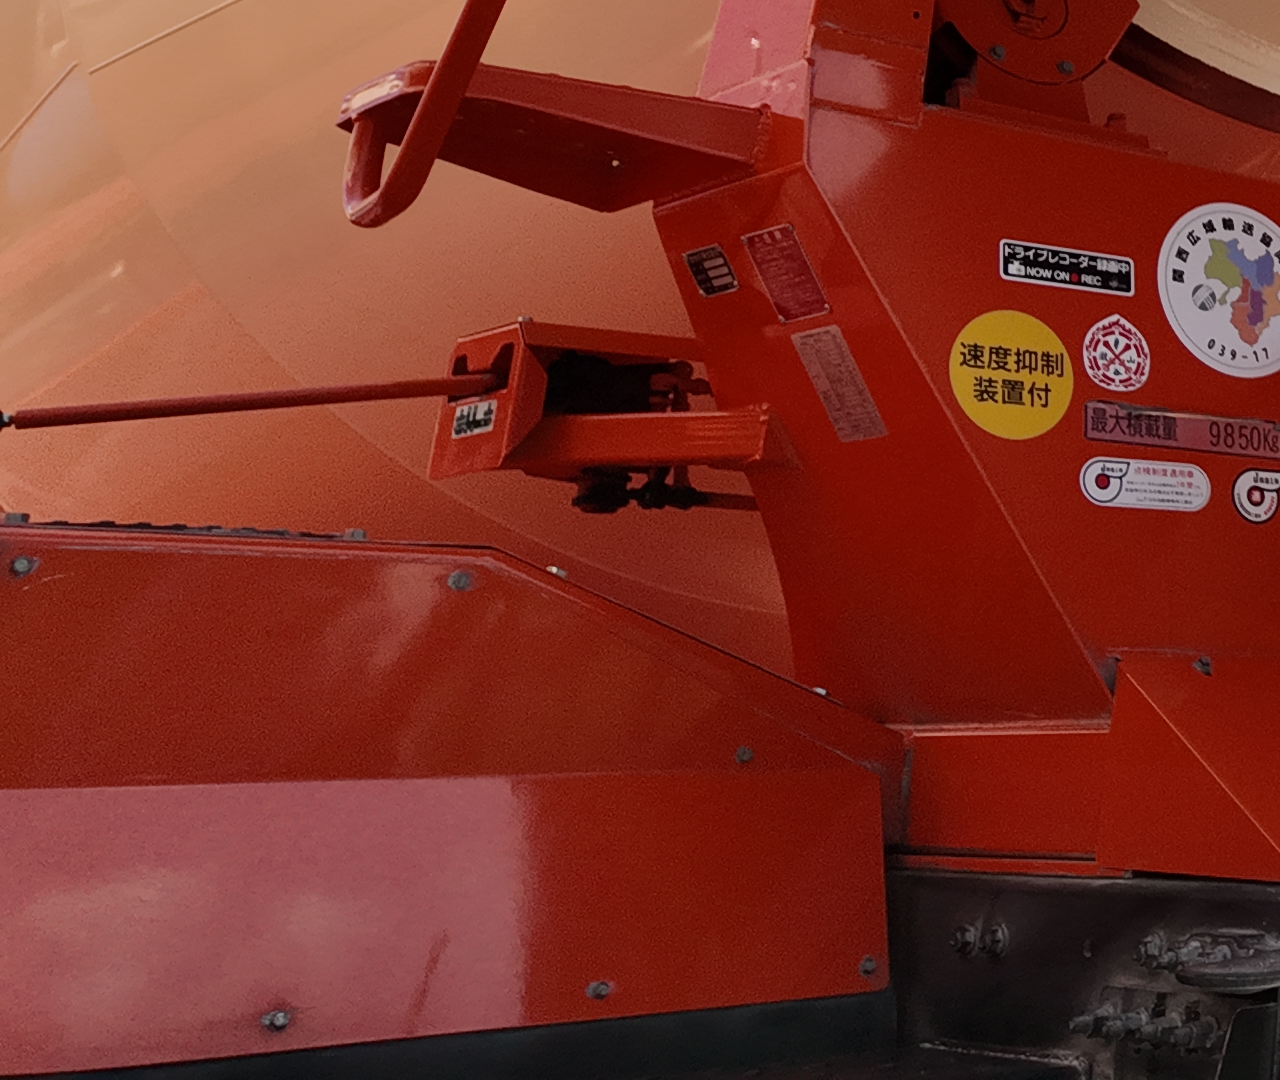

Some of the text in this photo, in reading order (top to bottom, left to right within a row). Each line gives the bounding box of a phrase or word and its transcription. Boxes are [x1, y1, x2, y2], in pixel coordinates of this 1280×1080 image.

[1026, 266, 1053, 279] NOW
[1054, 269, 1071, 282] ON
[1081, 274, 1103, 286] REC
[959, 341, 1064, 378] 速度抑制
[1207, 338, 1270, 363] 039-17
[973, 376, 1052, 408] 装置付
[1090, 407, 1178, 442] 最大積載量
